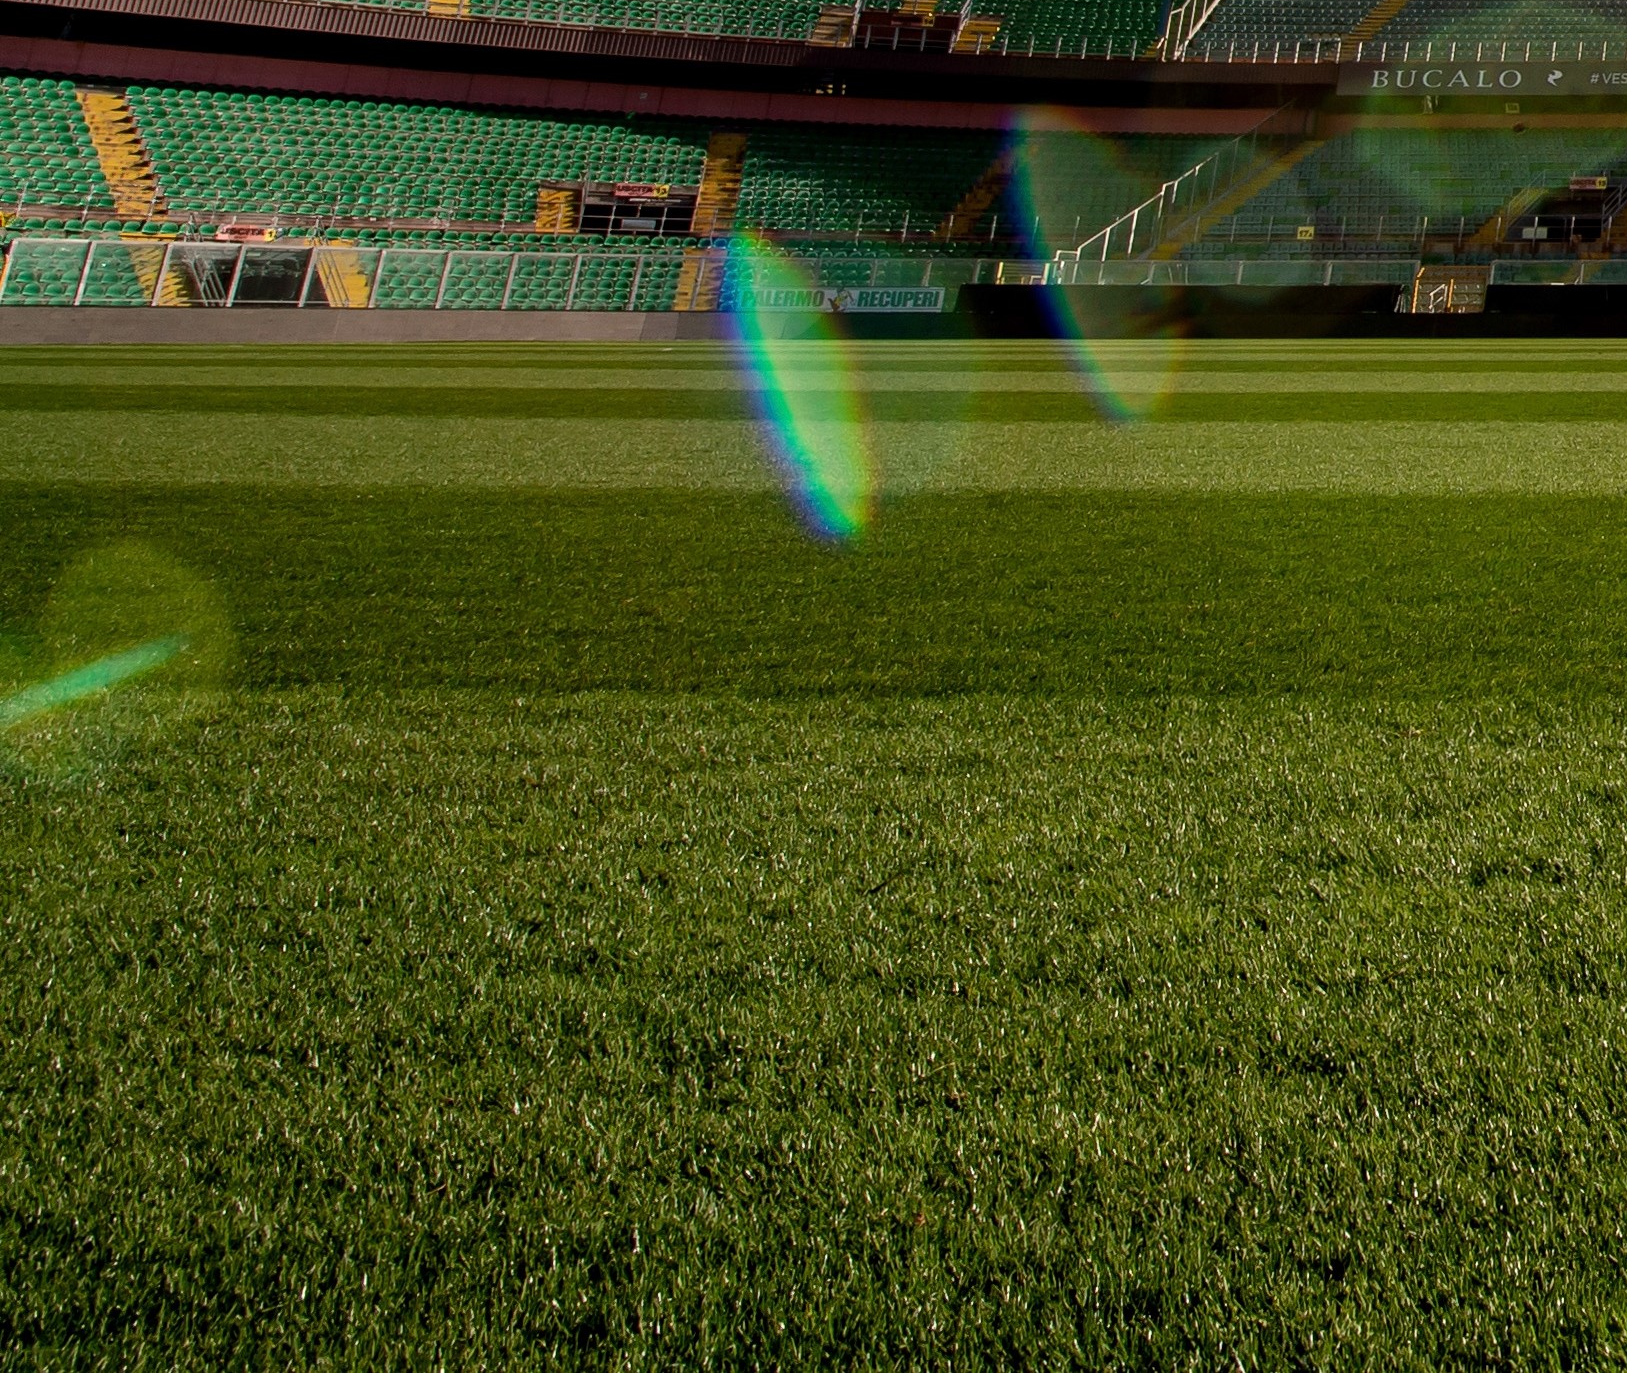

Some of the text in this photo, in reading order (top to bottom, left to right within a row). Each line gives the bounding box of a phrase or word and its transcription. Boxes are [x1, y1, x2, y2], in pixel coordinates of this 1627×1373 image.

[1372, 69, 1522, 88] BUCALO
[616, 183, 653, 194] USCITA
[742, 289, 940, 308] PALERMO RECUPERI
